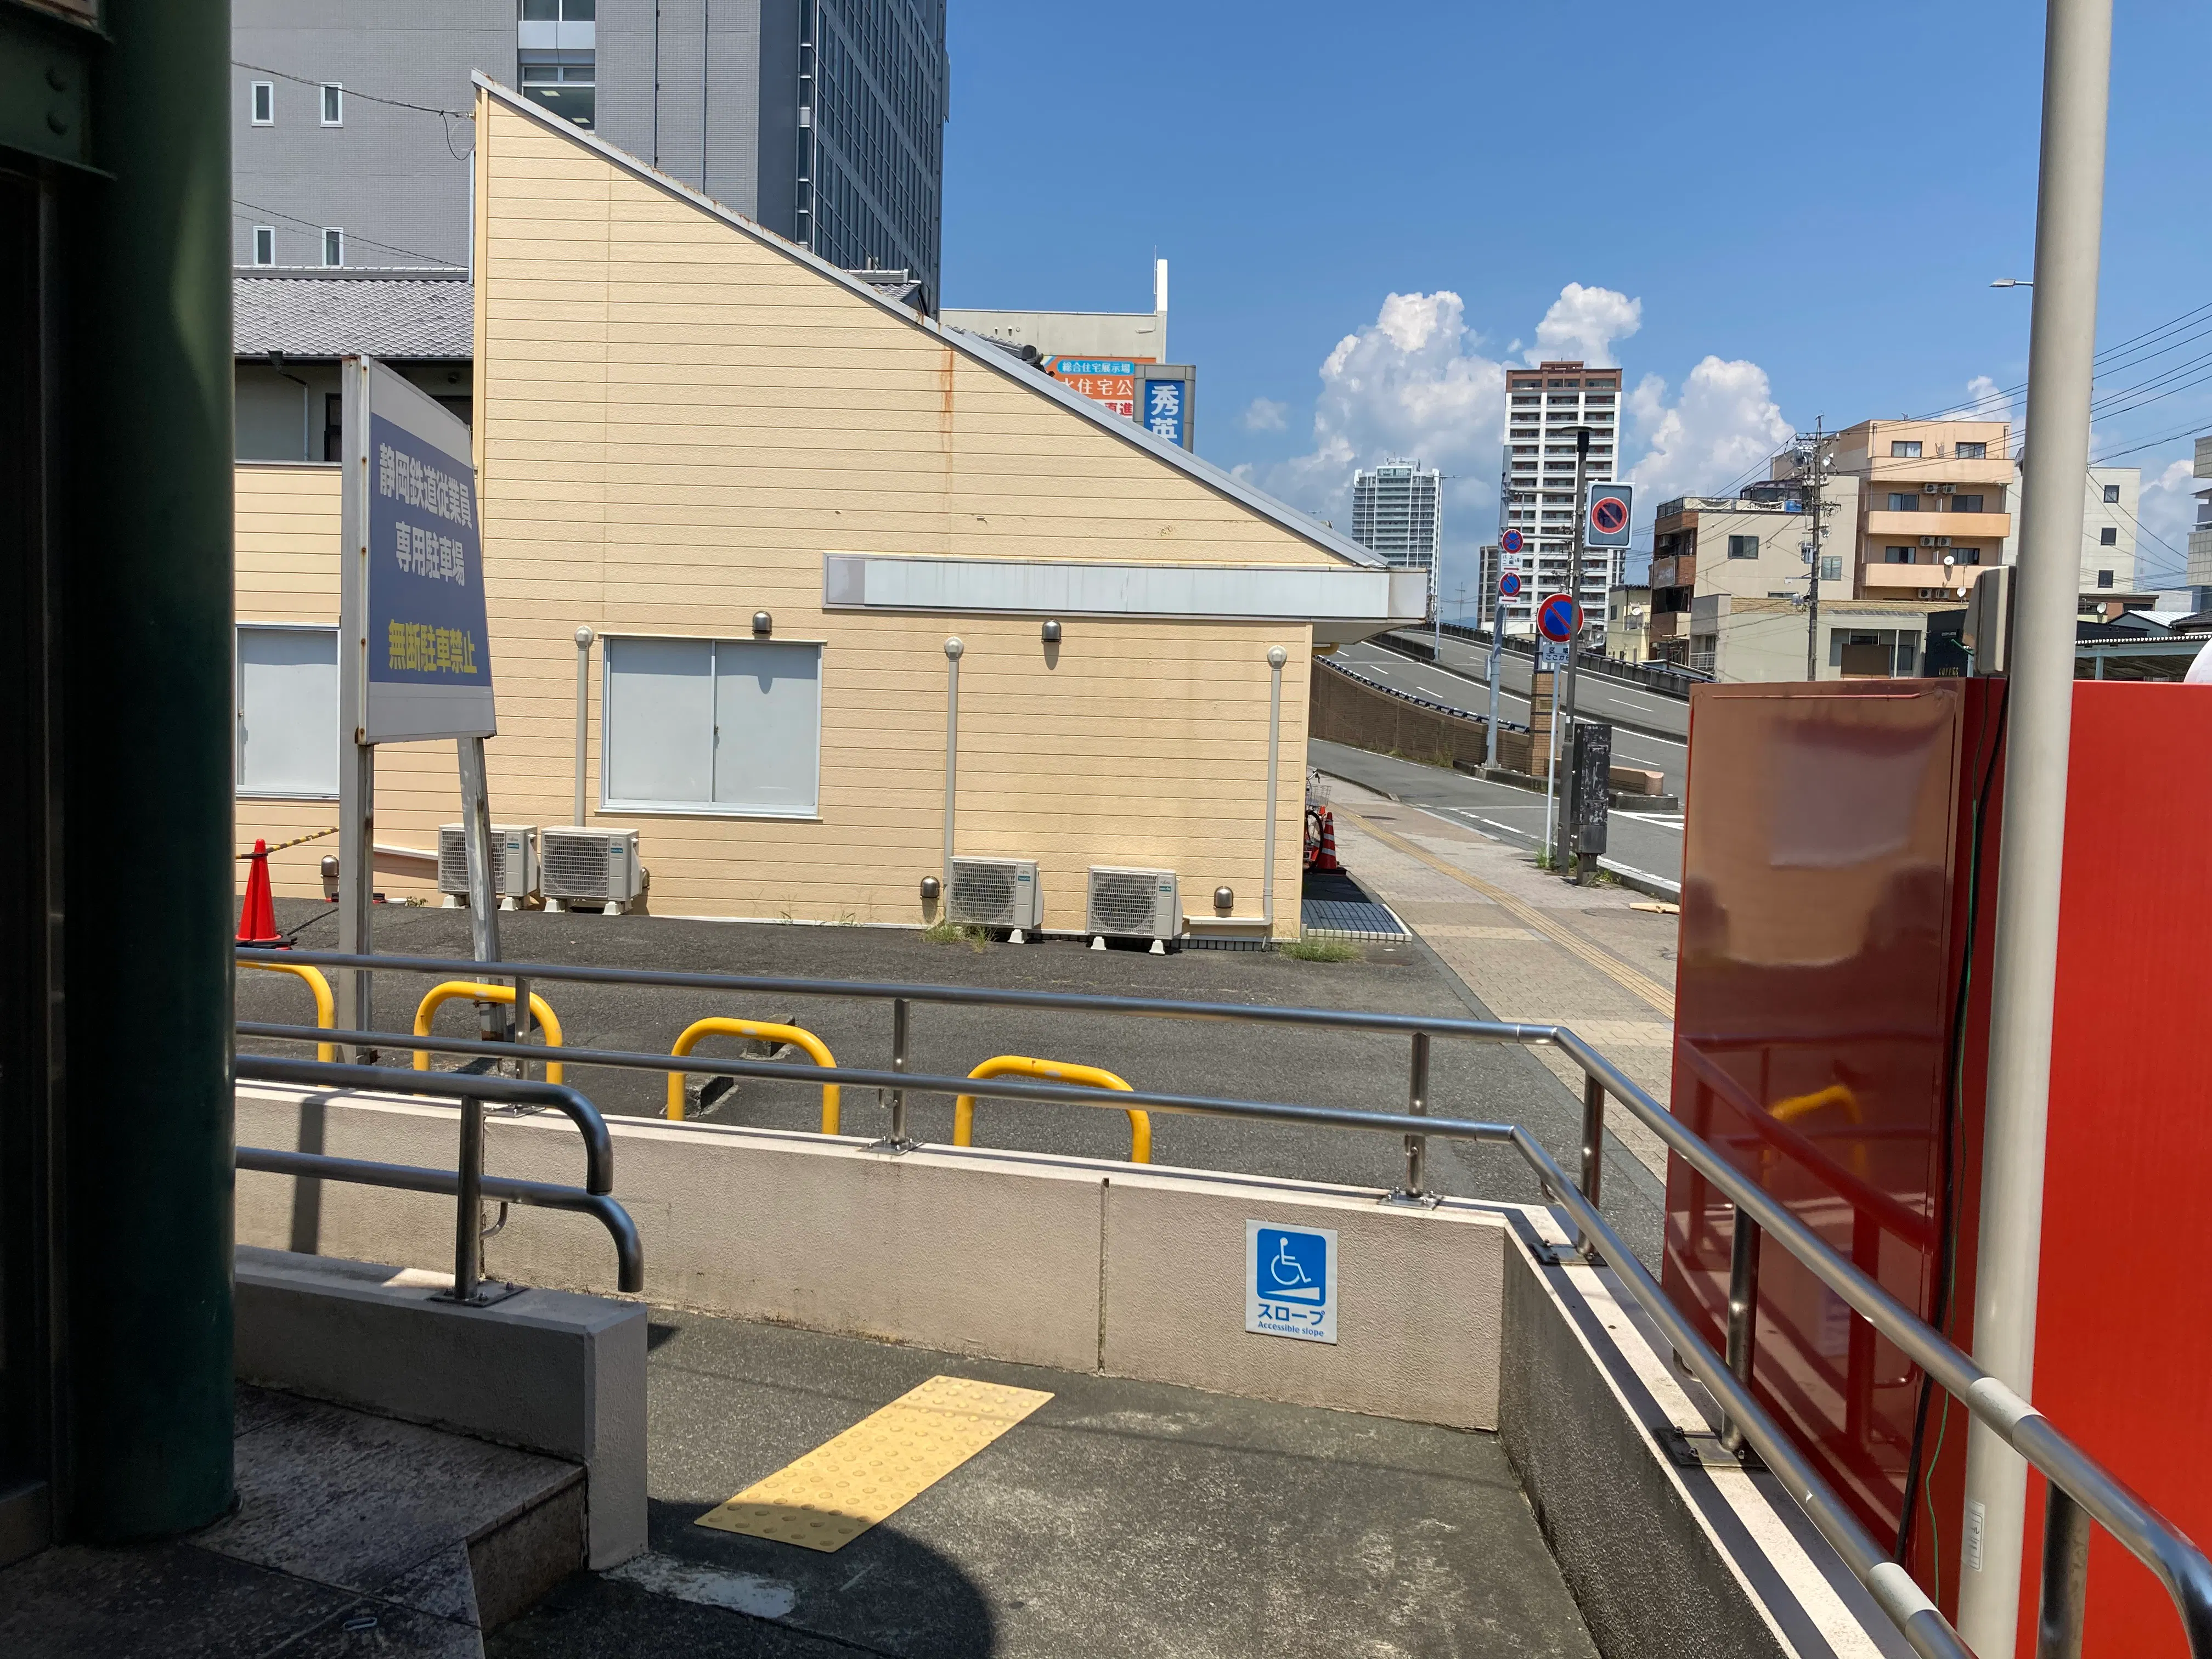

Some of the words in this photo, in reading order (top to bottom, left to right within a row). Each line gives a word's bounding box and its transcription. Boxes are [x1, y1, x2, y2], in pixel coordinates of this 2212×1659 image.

[1062, 362, 1131, 373] 総合住宅展示場
[1150, 385, 1180, 439] 秀英
[380, 443, 472, 530] 静岡鉄道従業員
[396, 521, 465, 586] 専用駐車場
[388, 618, 477, 674] 無断駐車禁止
[1257, 1303, 1325, 1325] スロープ
[1258, 1321, 1300, 1333] Accessible
[1302, 1328, 1324, 1338] slope
